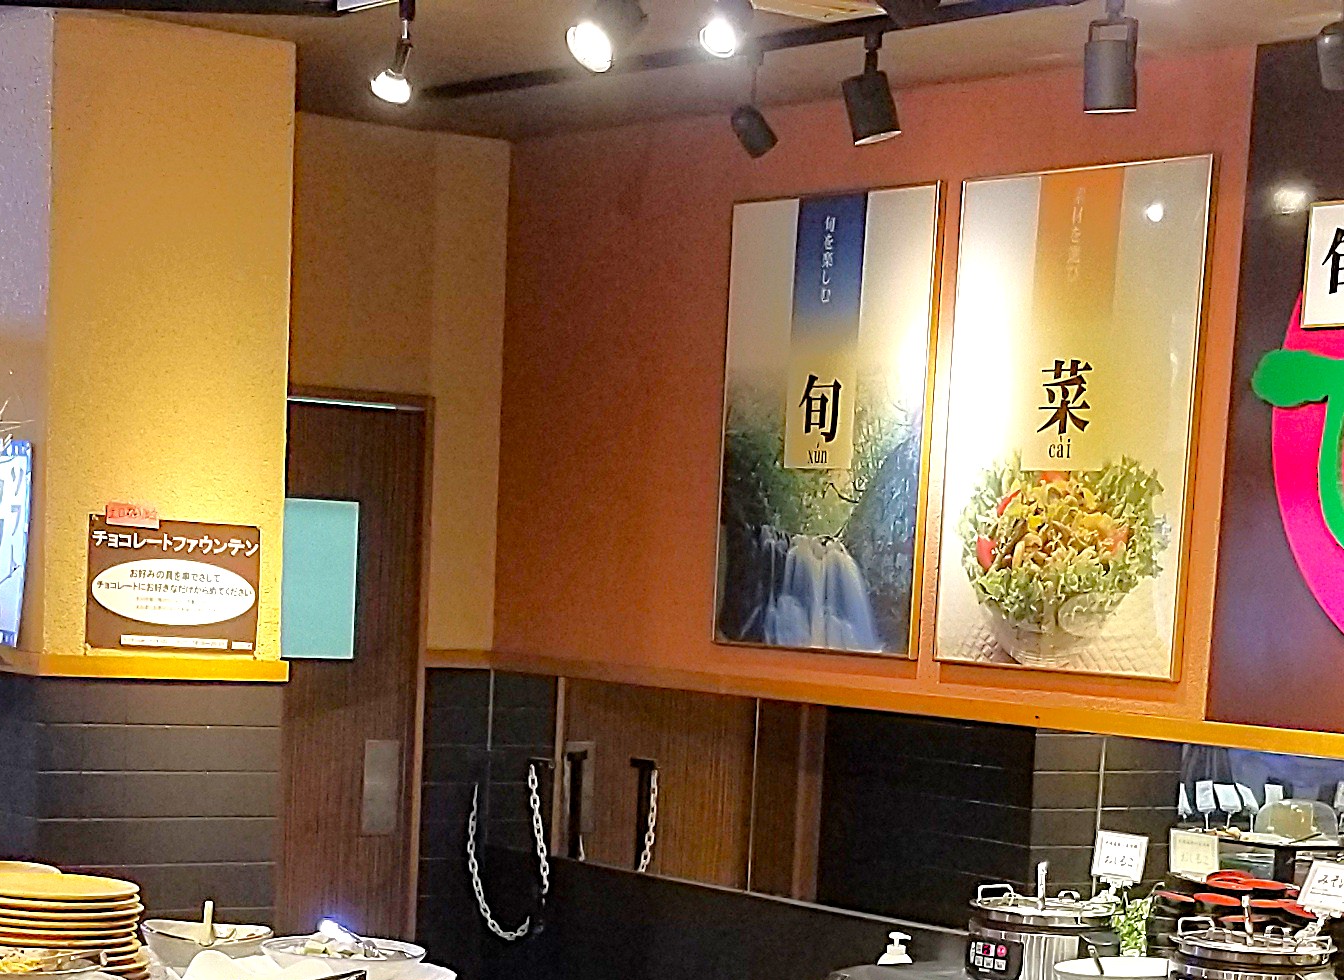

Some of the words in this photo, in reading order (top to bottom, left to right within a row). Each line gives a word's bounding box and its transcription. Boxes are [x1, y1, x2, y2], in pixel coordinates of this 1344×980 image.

[820, 215, 837, 304] 旬を楽しむ
[798, 373, 843, 443] 旬
[1036, 359, 1093, 435] 菜
[92, 530, 259, 557] チョコレートファウンテン
